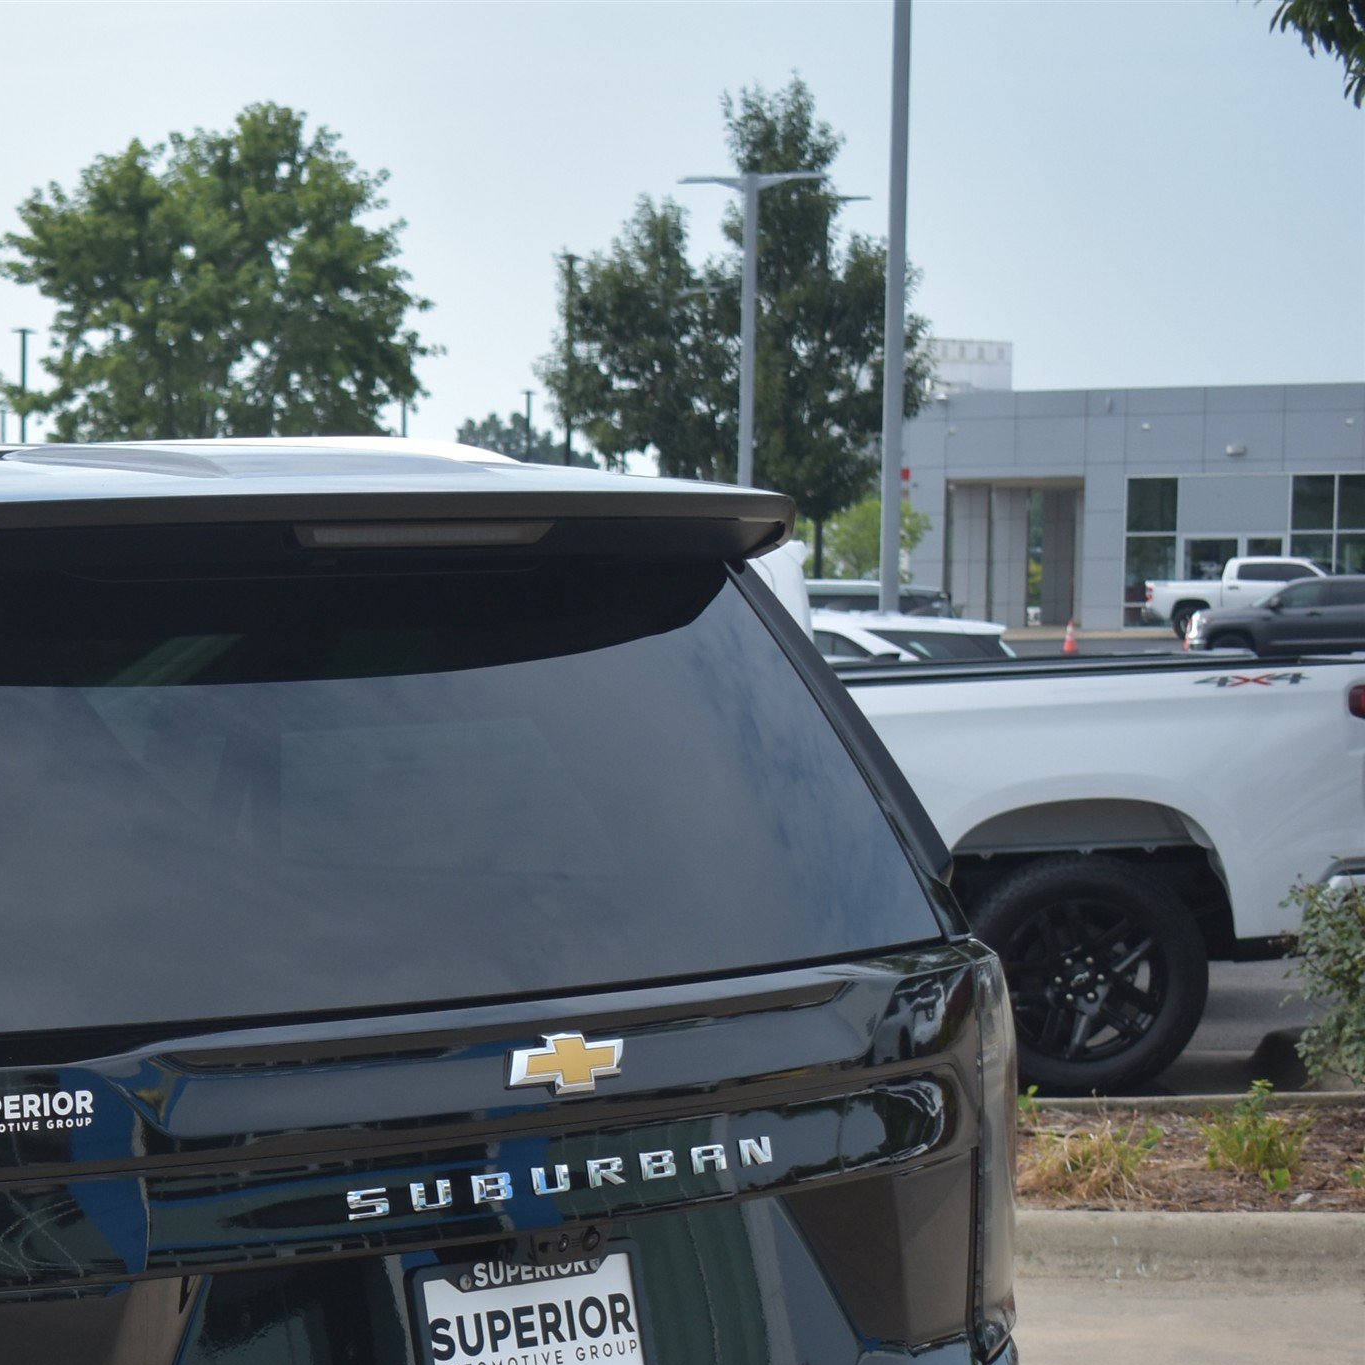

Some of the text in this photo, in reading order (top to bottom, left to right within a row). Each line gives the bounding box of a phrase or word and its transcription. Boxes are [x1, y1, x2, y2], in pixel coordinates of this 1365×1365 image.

[46, 1117, 92, 1130] GROUP
[346, 1136, 773, 1222] SUBURBAN
[429, 1292, 635, 1361] SUPERIOR
[575, 1339, 638, 1361] GROUP
